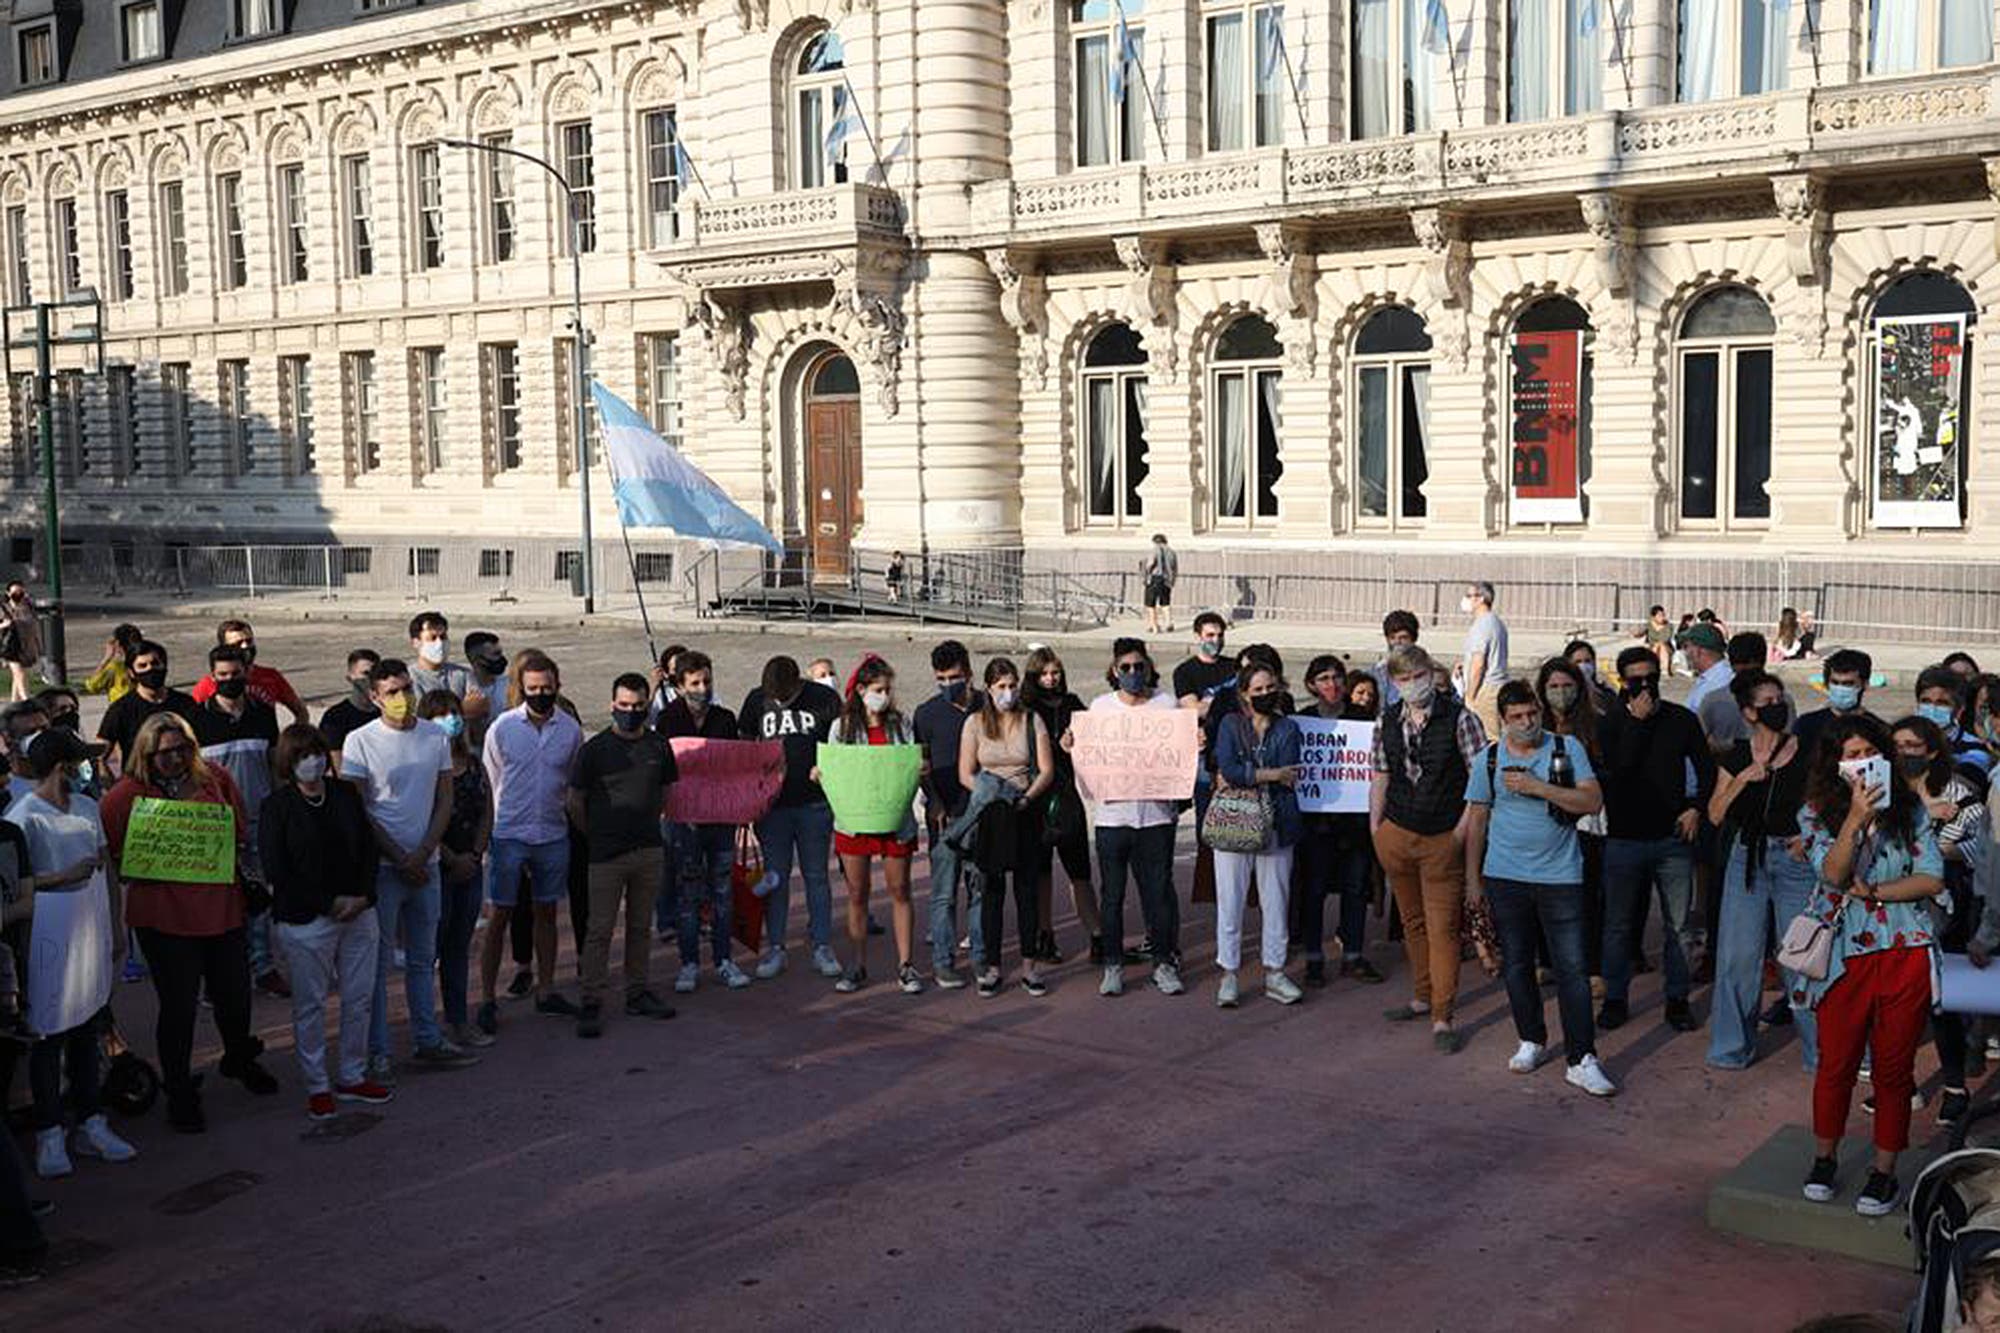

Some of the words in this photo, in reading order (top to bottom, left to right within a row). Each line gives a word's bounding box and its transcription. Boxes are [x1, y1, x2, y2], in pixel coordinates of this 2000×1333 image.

[1512, 344, 1548, 486] BNM
[763, 710, 816, 738] GAP
[1297, 767, 1316, 780] DE
